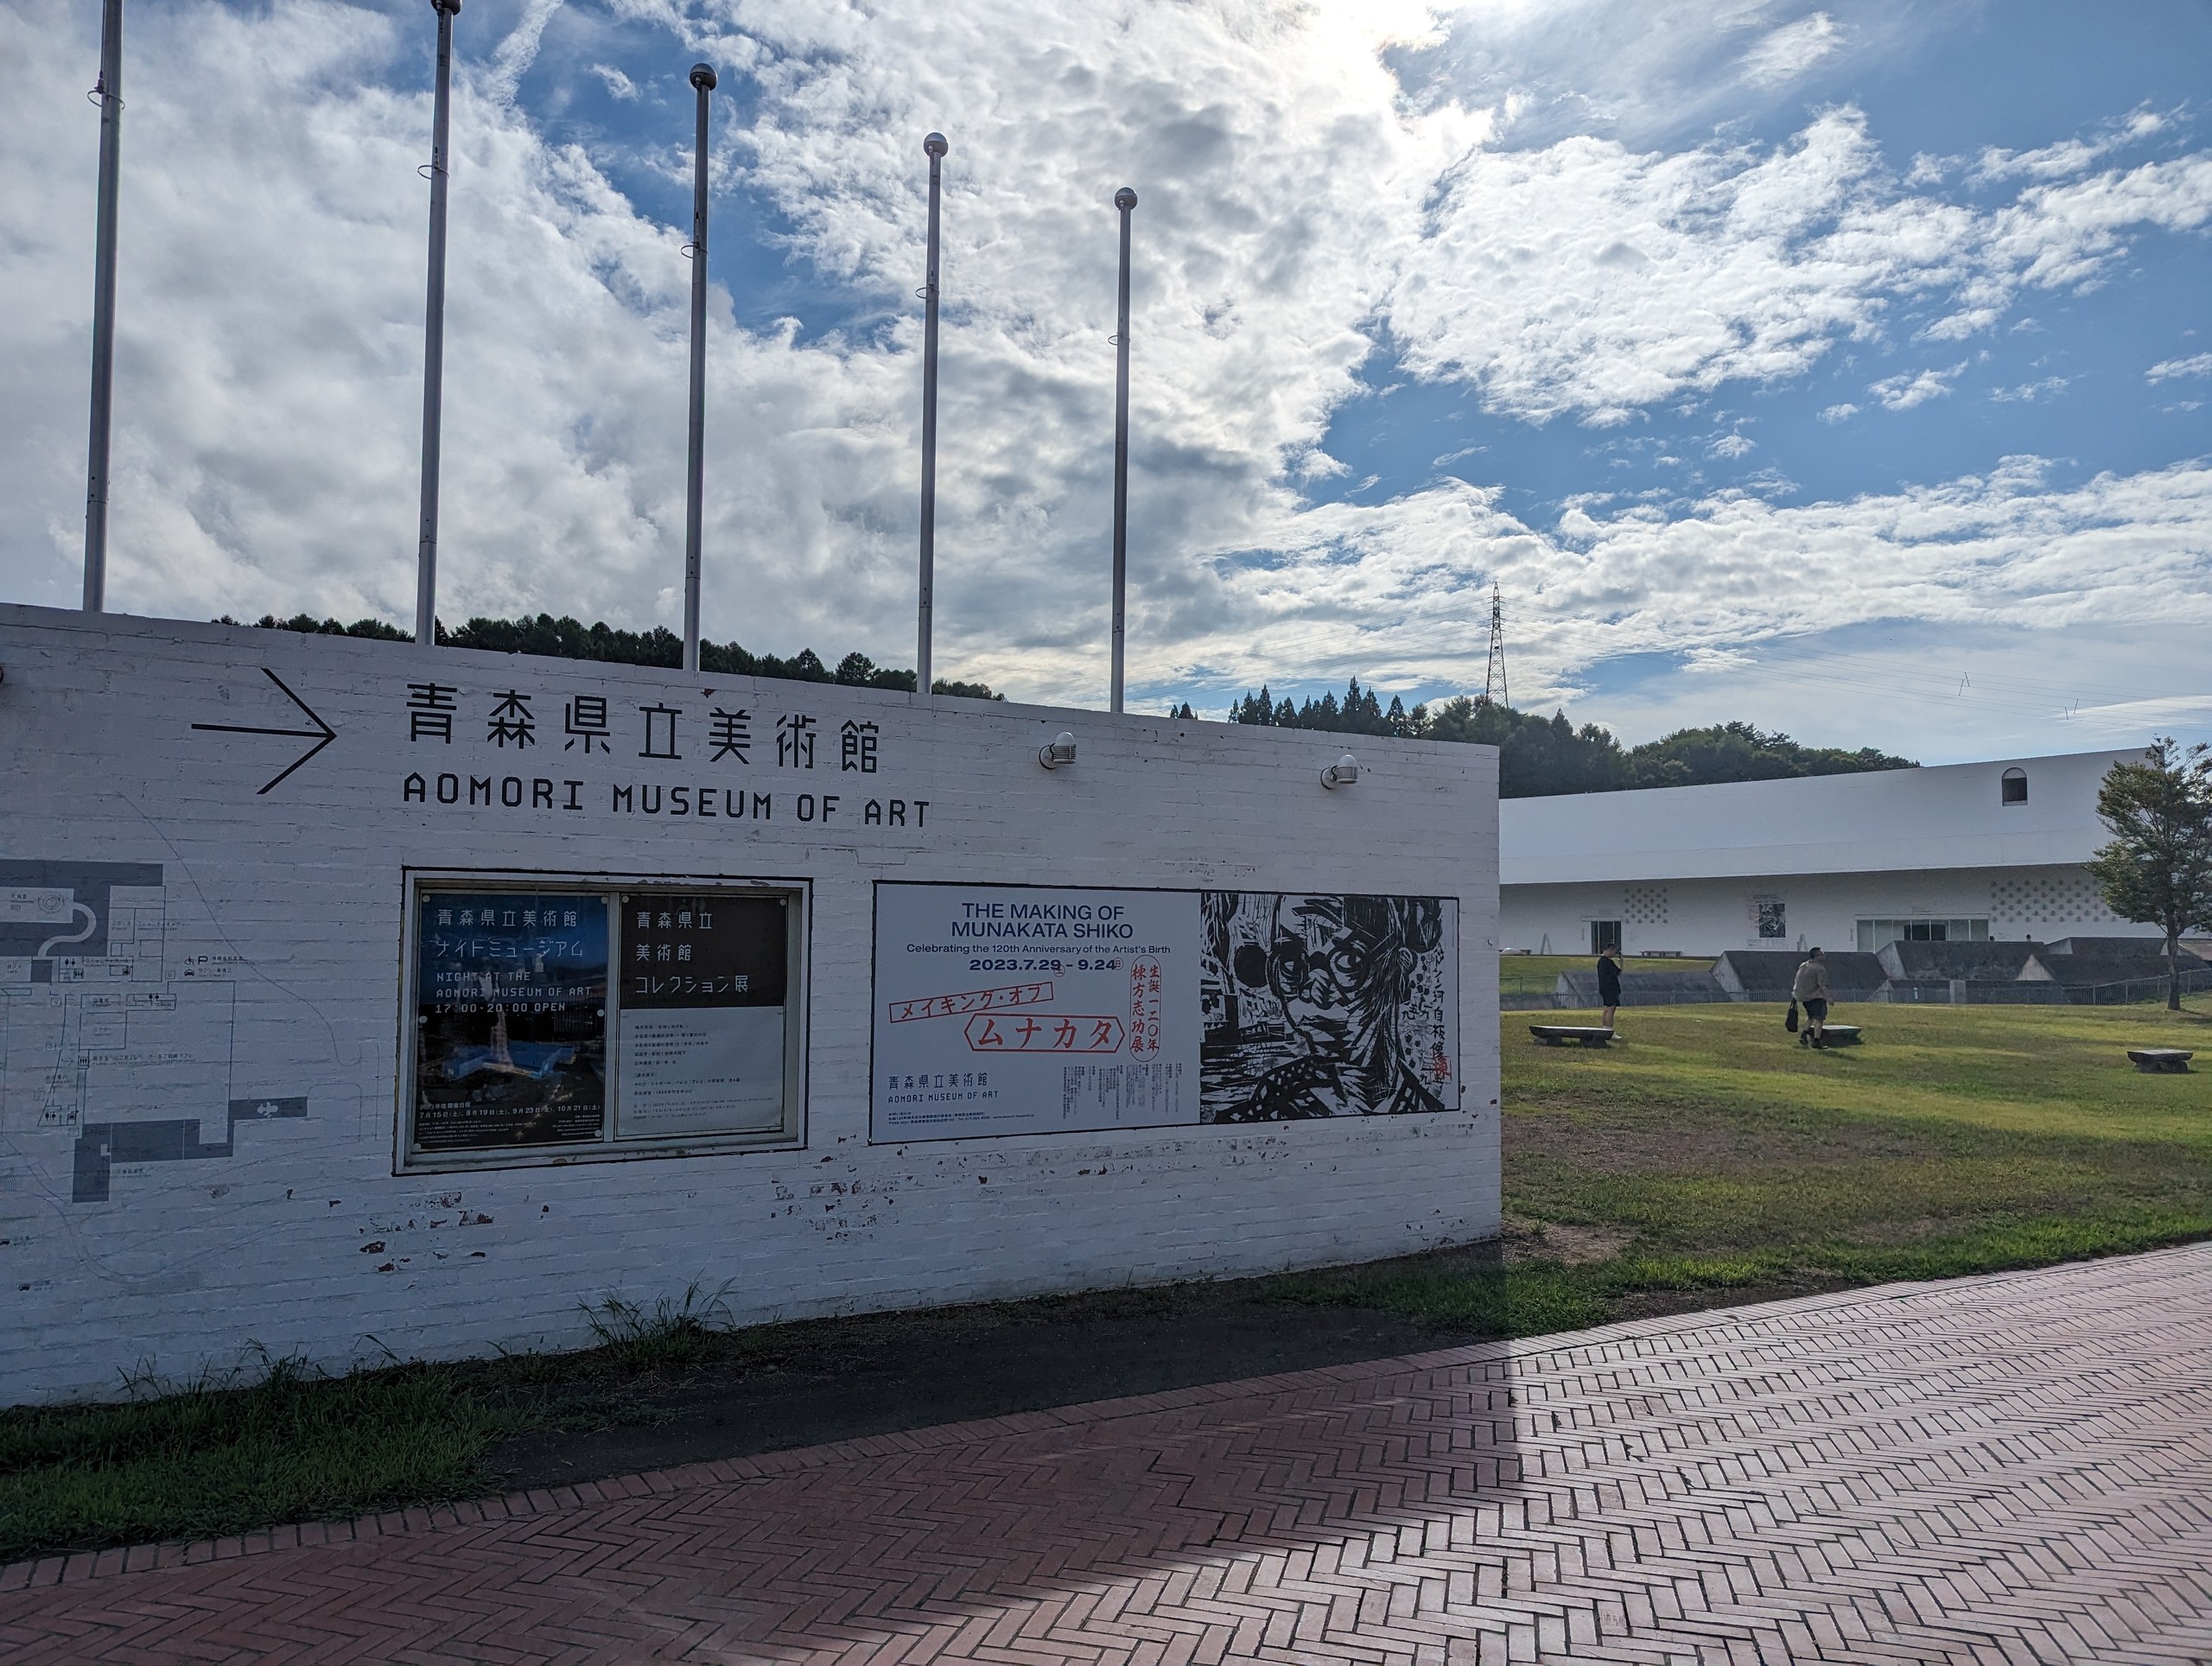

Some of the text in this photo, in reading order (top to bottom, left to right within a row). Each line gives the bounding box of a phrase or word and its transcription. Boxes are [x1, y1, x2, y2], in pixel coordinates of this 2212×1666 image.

[406, 683, 879, 773] 青森県立美術館
[403, 772, 931, 828] AOMORI MUSEUM OF ART
[437, 909, 577, 927] 青森県立美術館
[637, 912, 712, 929] 青森県立
[962, 903, 1124, 921] THE MAKING OF
[951, 921, 1134, 938] MUNAKATA SHIKO
[437, 939, 582, 957] ナイトミュージアム
[636, 944, 691, 961] 美術館
[906, 944, 969, 955] Celebrating
[972, 944, 989, 953] the
[992, 944, 1020, 953] 120th
[1022, 944, 1082, 955] Anniversary
[1083, 944, 1093, 954] of
[1113, 945, 1147, 954] Artist's
[1148, 945, 1171, 954] Birth
[969, 959, 1061, 971] 2023.7.29
[436, 972, 531, 982] NIGHT AT THE
[636, 975, 748, 994] コレクション展
[435, 986, 592, 998] AOMORI MUSEUM OF ART
[534, 1002, 566, 1012] OPEN
[900, 985, 1045, 1020] メイキング・オブ
[1131, 964, 1147, 1052] 棟方志功展
[978, 1017, 1113, 1049] ムナカタ
[888, 1072, 988, 1091] 青森県立美術館
[888, 1095, 924, 1104] AOMORI
[928, 1093, 964, 1102] MUSEUM
[982, 1091, 999, 1100] ART
